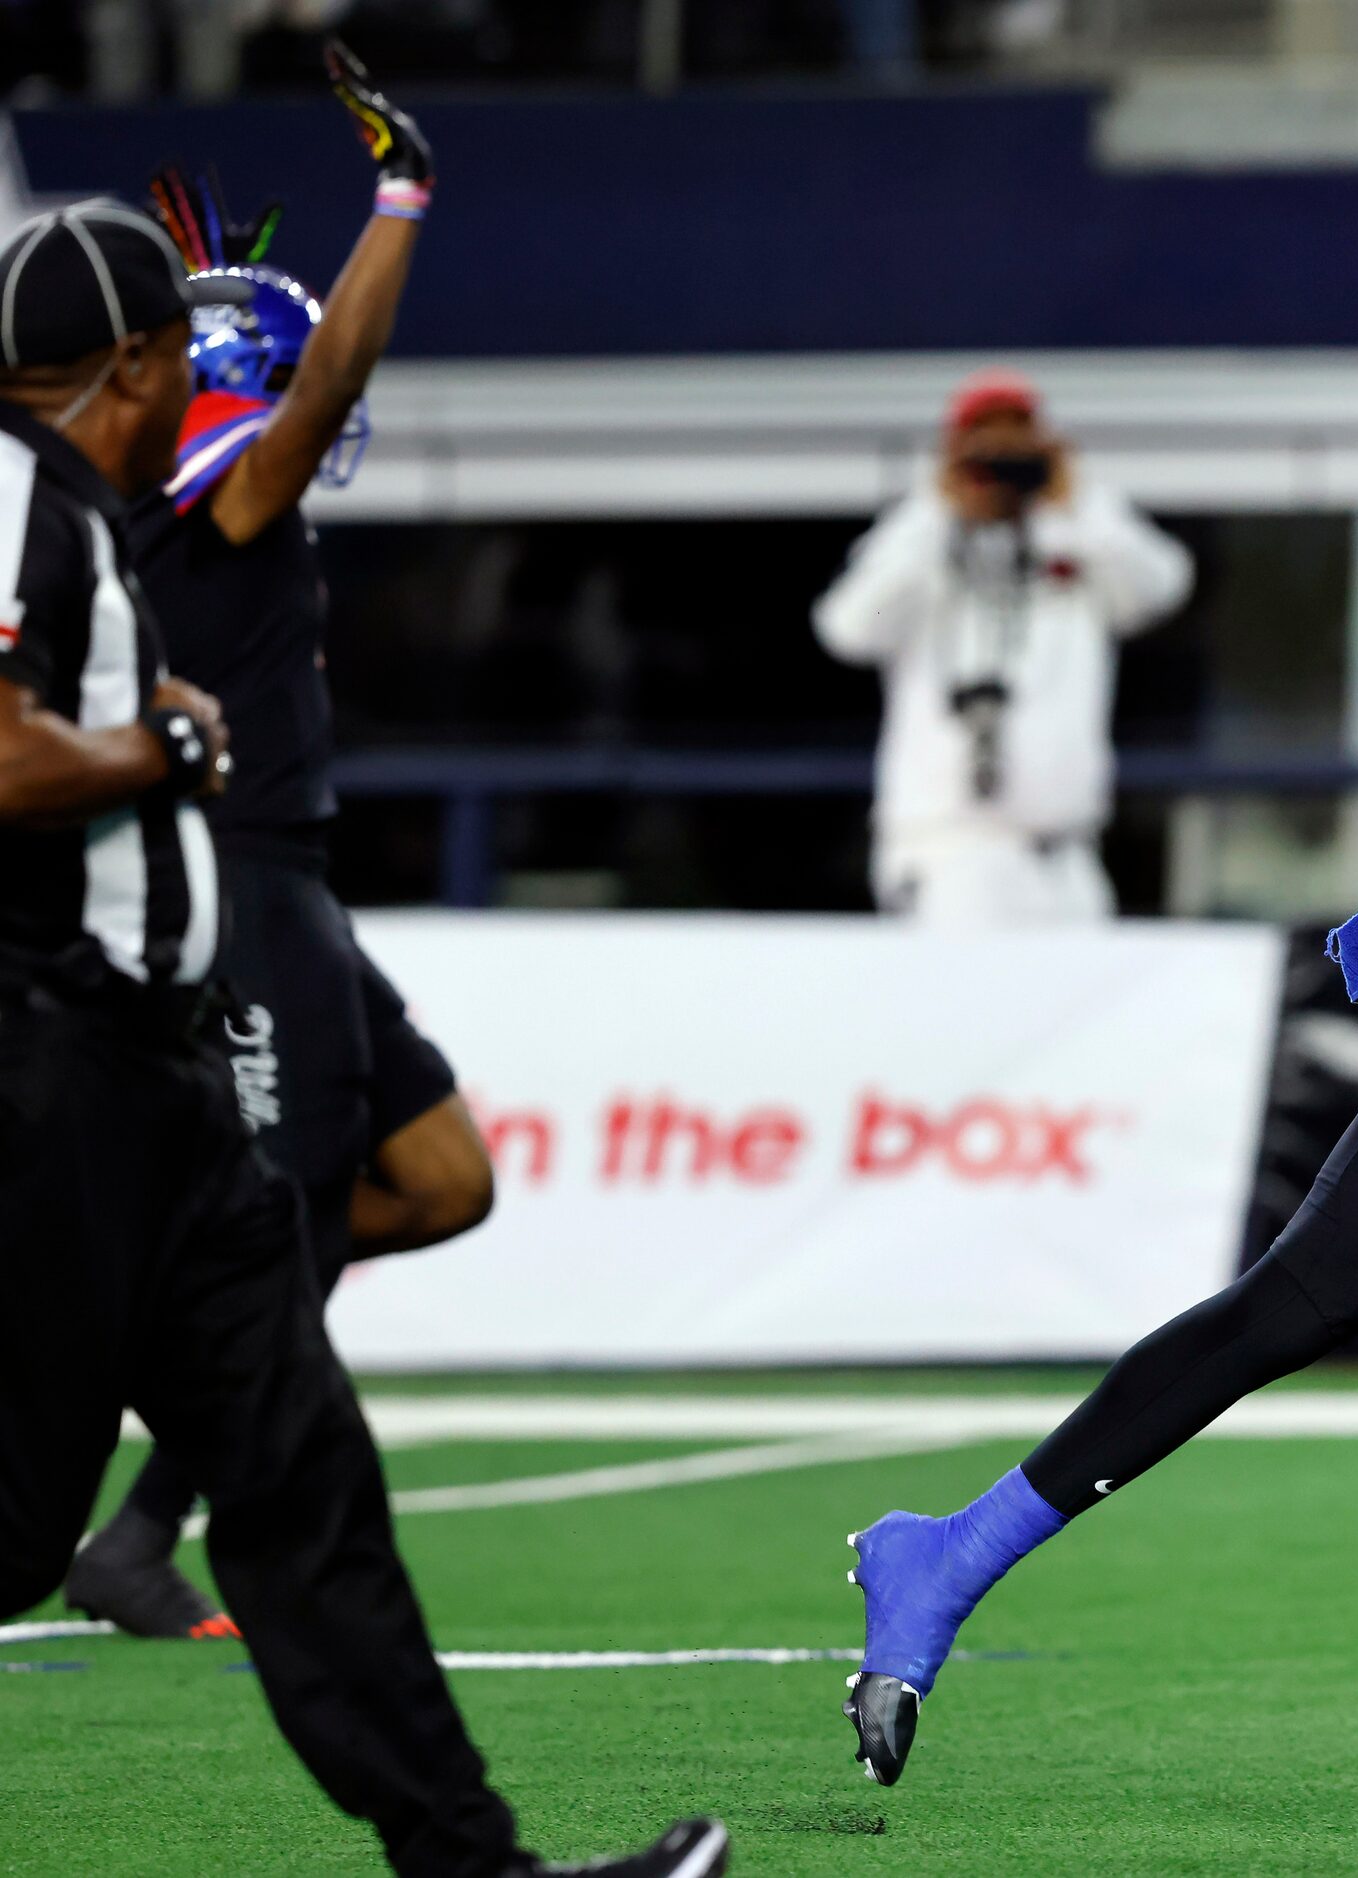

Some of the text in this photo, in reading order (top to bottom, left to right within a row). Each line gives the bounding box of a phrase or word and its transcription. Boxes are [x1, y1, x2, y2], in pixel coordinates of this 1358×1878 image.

[471, 1088, 1096, 1188] n the box
